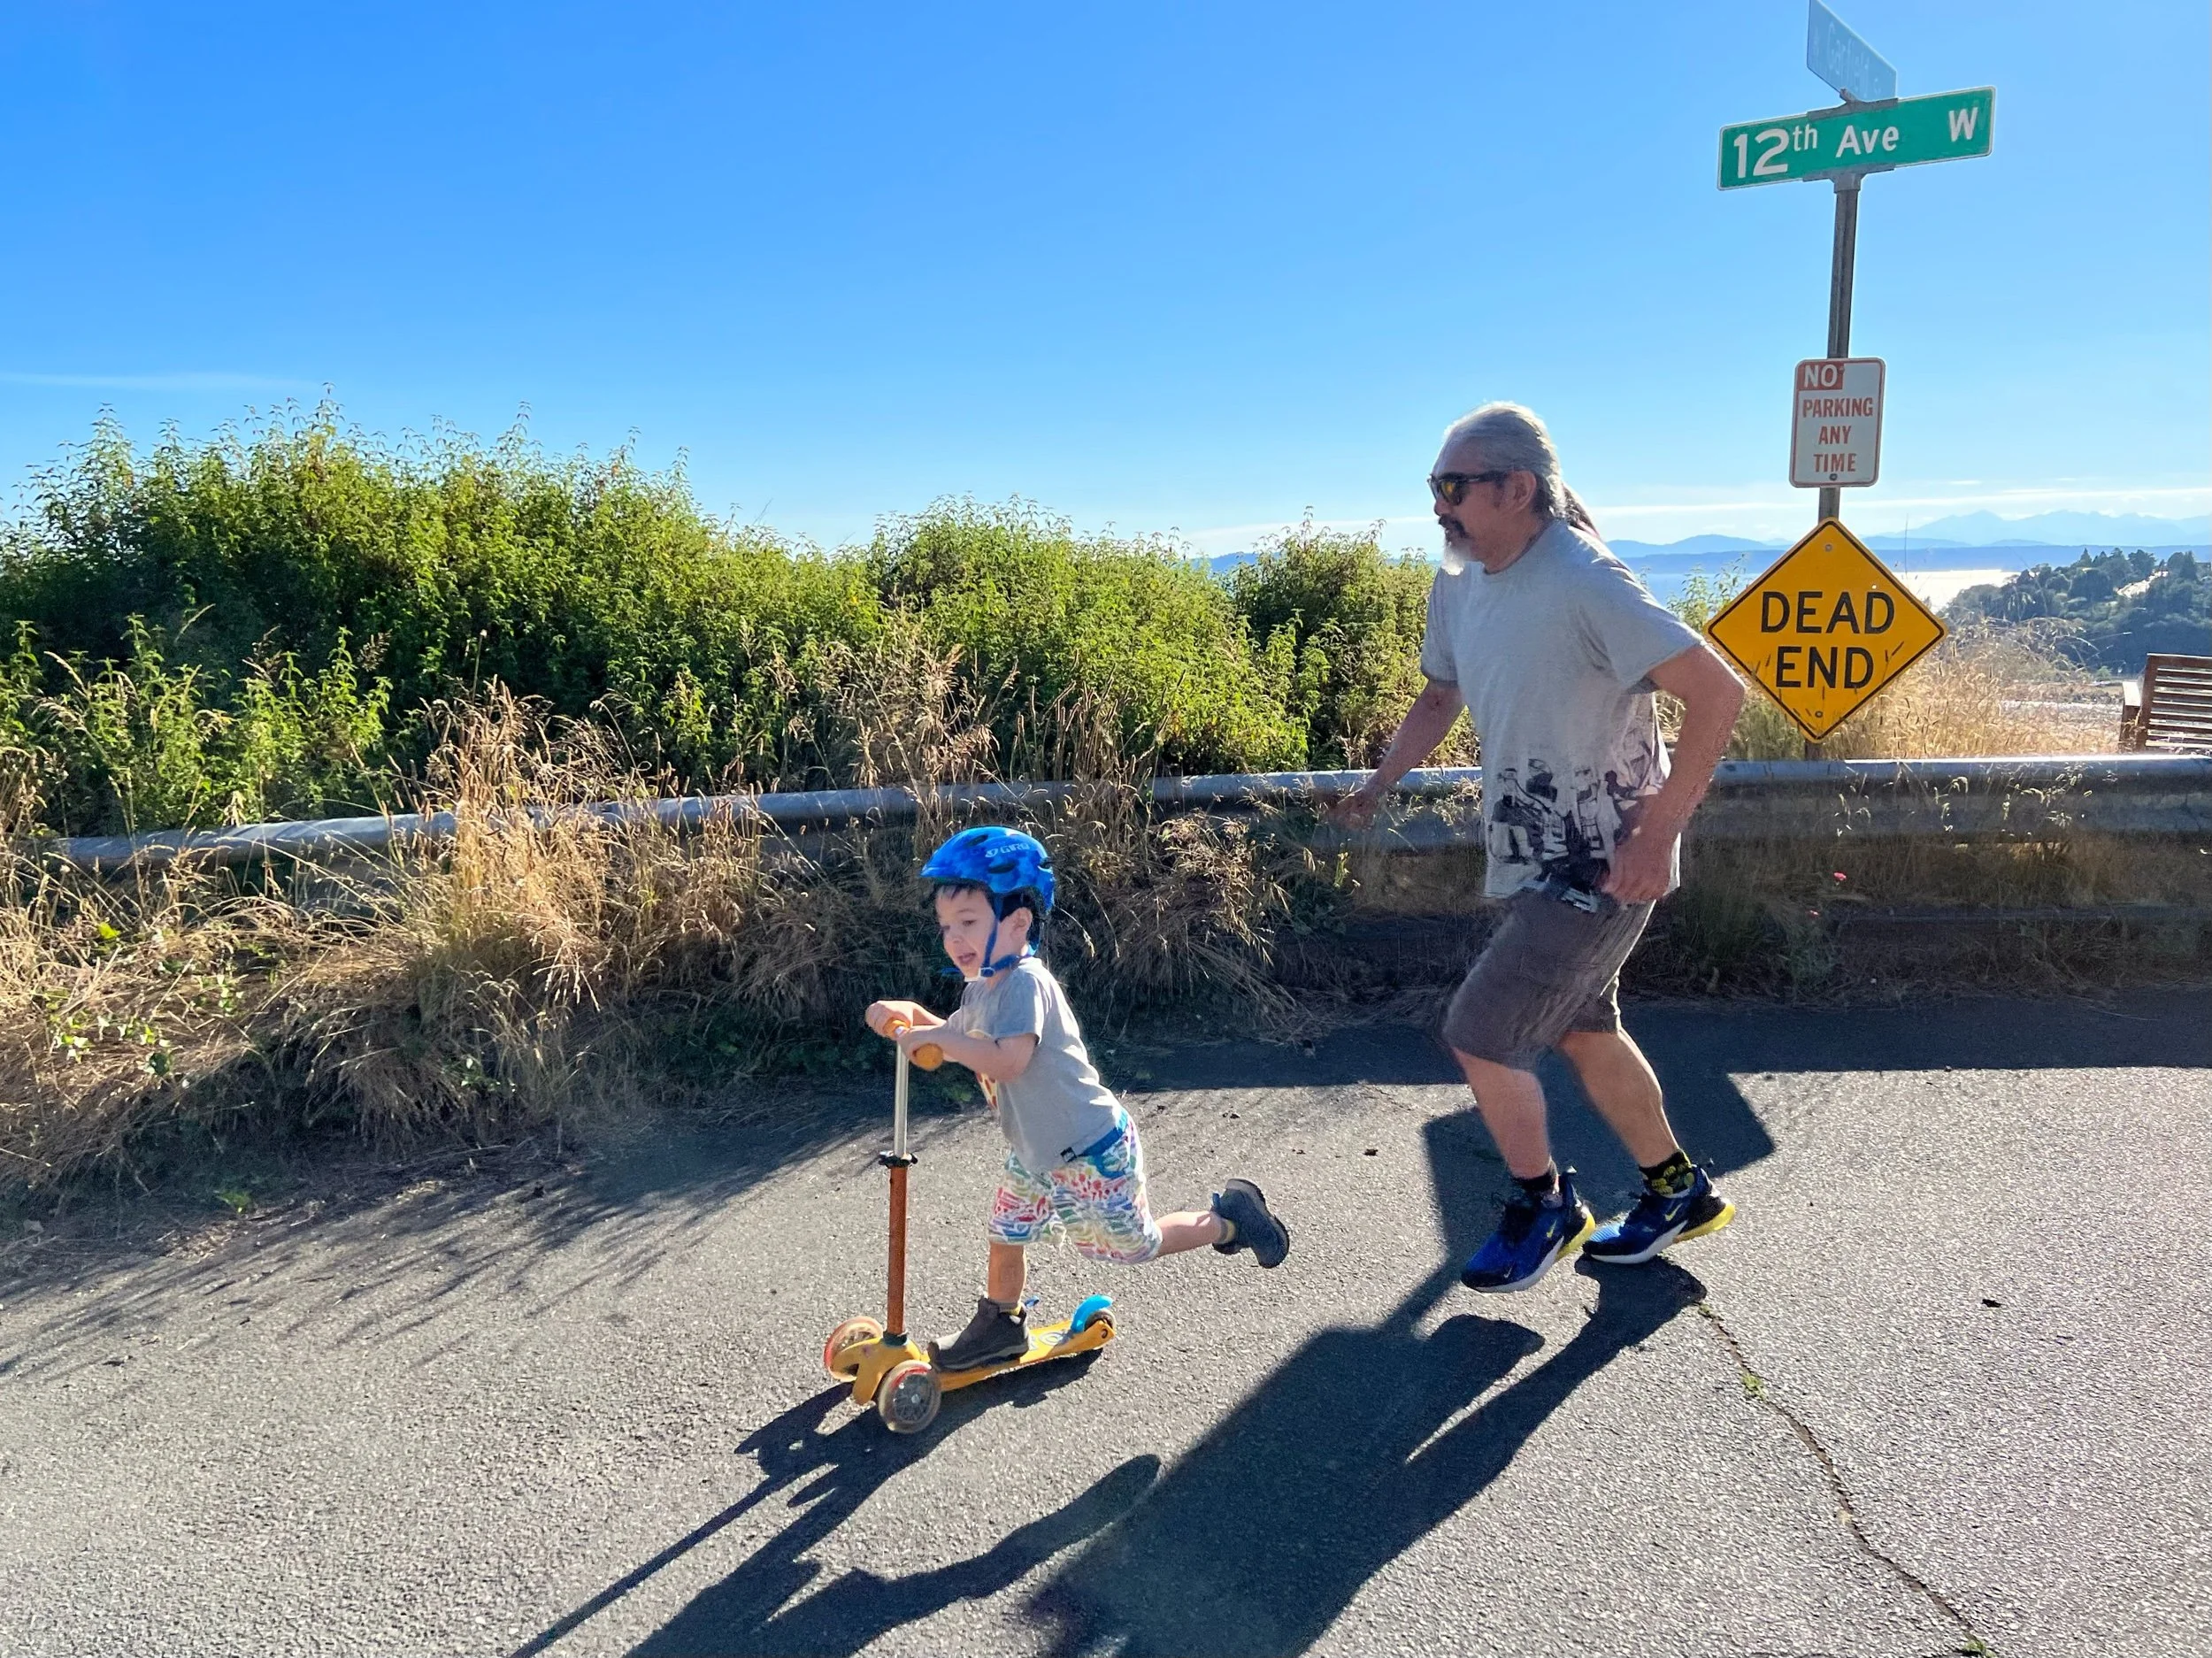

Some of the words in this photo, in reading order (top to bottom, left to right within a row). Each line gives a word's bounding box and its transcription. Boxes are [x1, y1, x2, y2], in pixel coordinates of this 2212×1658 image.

[1732, 123, 1818, 179] 12th
[1835, 124, 1900, 157] Ave
[1948, 106, 1978, 142] W
[1803, 364, 1838, 388] NO
[1802, 396, 1873, 418] PARKING
[1818, 426, 1852, 444] ANY
[1814, 453, 1857, 472] TIME
[1761, 591, 1895, 634] DEAD
[1775, 646, 1874, 689] END
